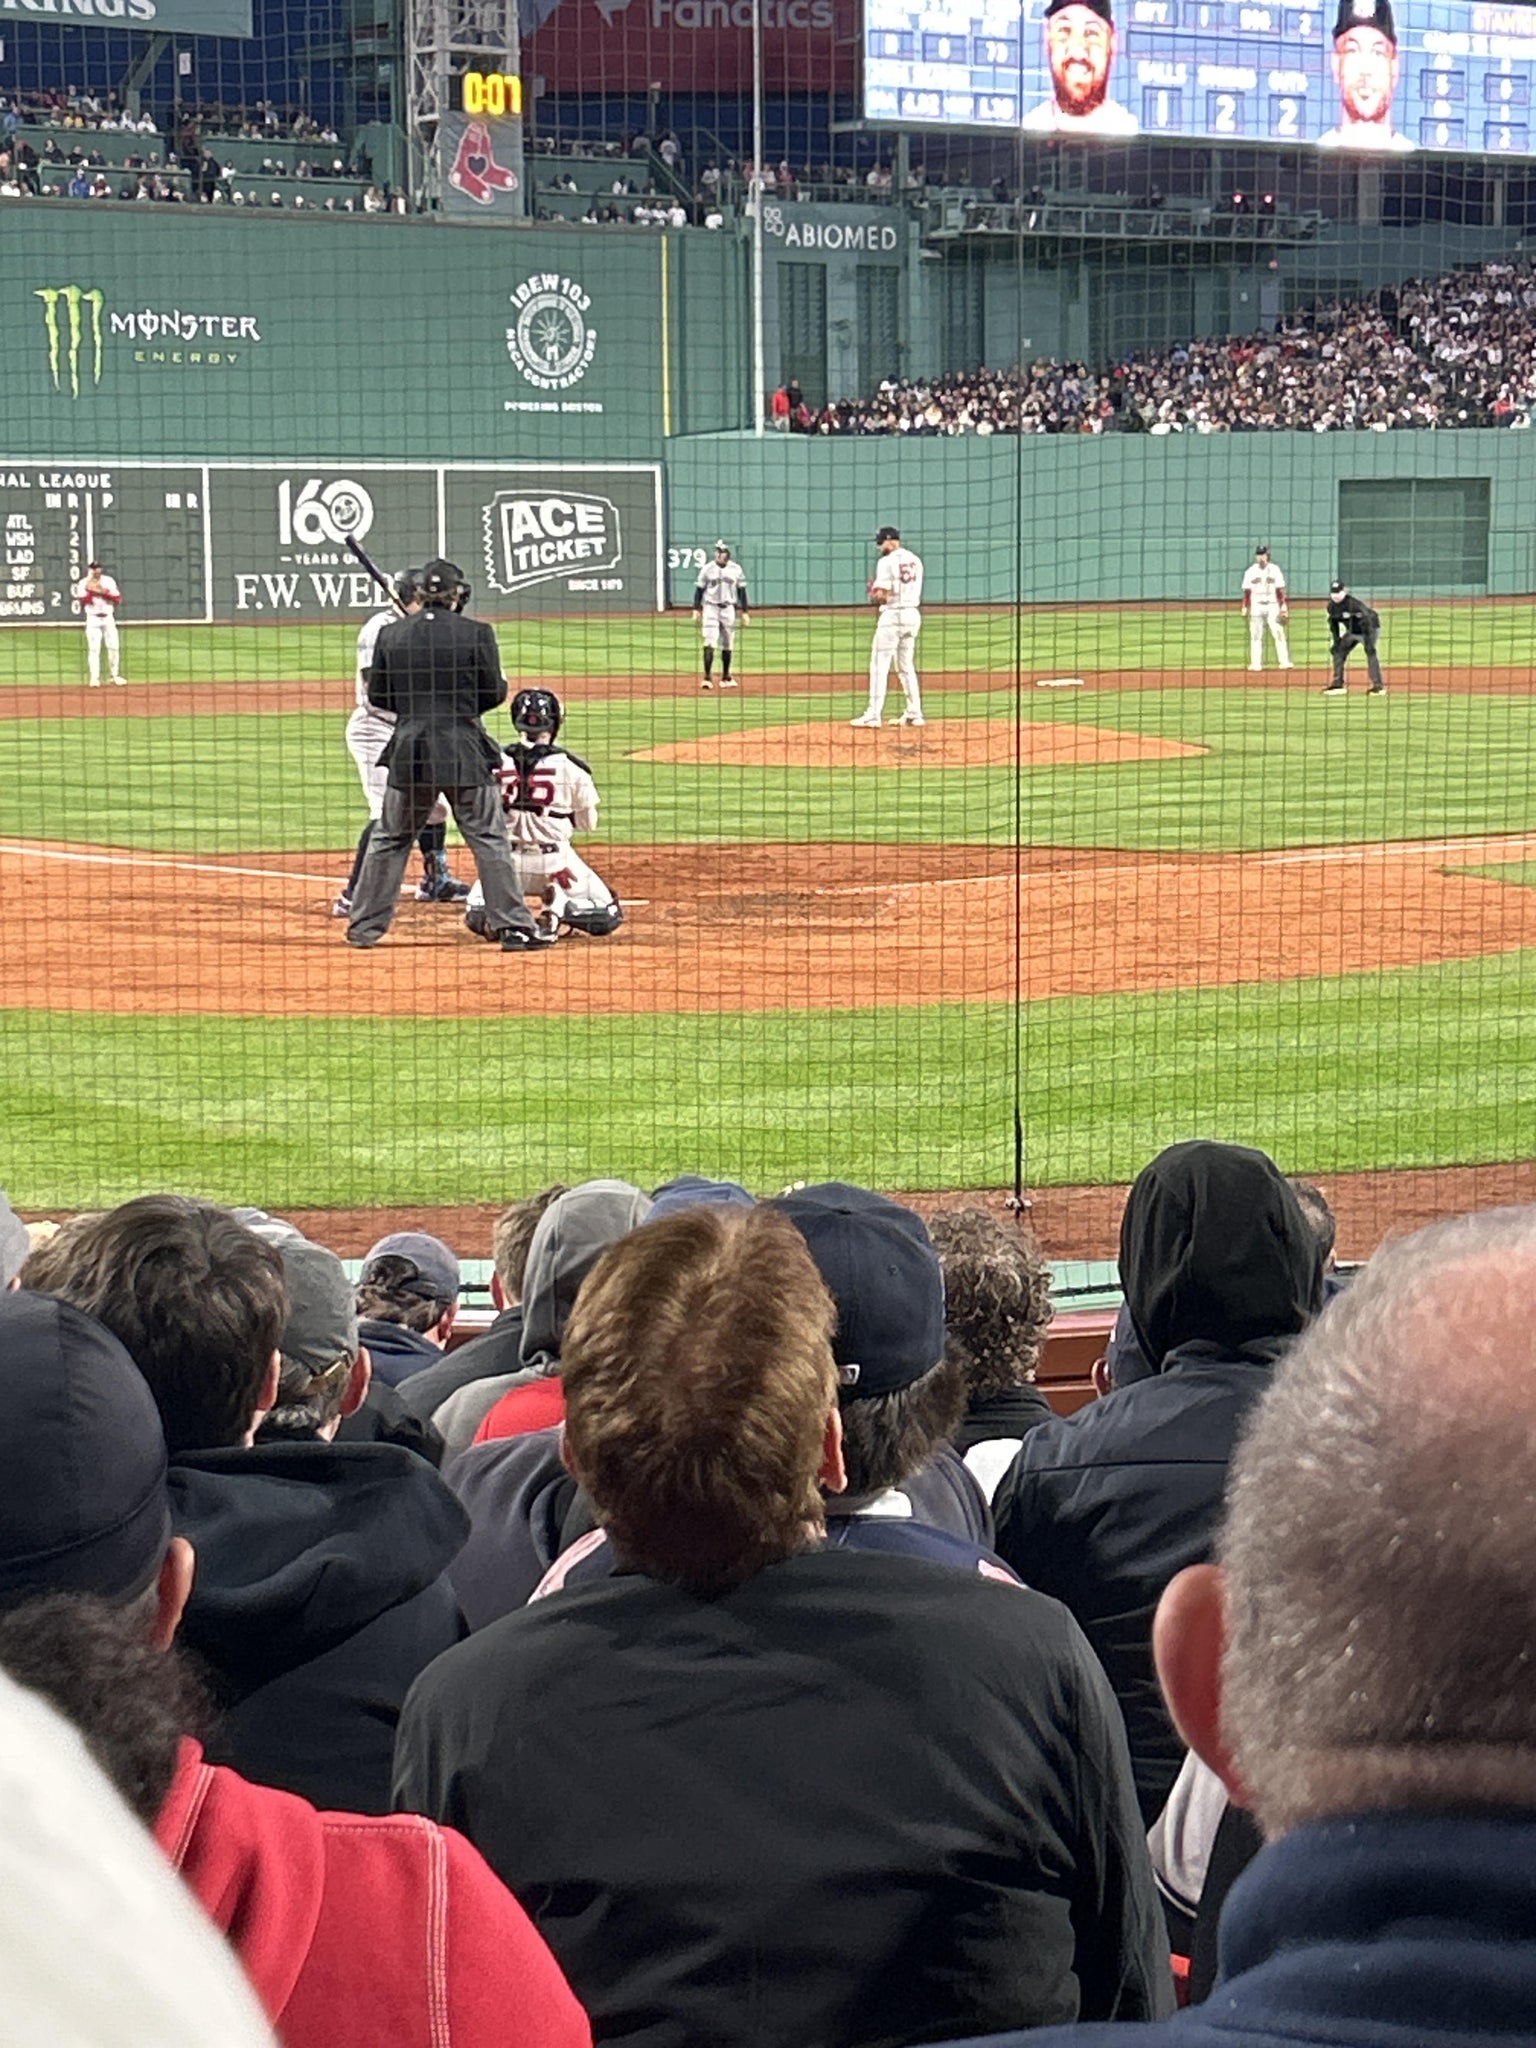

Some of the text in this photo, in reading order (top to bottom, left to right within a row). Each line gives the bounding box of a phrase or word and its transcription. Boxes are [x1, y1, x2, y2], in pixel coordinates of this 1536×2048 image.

[653, 0, 834, 28] Fanatics
[463, 72, 522, 115] 0:07
[1216, 95, 1235, 132] 2
[1278, 99, 1298, 136] 2
[785, 223, 897, 250] ABIOMED
[110, 308, 262, 342] MONSTER
[134, 350, 239, 365] ENERGY
[39, 473, 112, 488] LEAGUE
[67, 493, 79, 508] R
[102, 493, 114, 508] P
[186, 493, 198, 508] R
[278, 479, 374, 545] 160
[511, 499, 606, 543] ACE
[6, 514, 33, 529] ATL
[69, 532, 80, 546] 2
[6, 549, 79, 564] LAD 3
[295, 553, 339, 565] YEARS
[513, 537, 607, 570] TICKET
[668, 548, 707, 569] 379
[11, 566, 80, 581] SF 0
[51, 592, 62, 607] 2
[235, 572, 402, 610] F.W. WEB
[71, 600, 82, 615] 0
